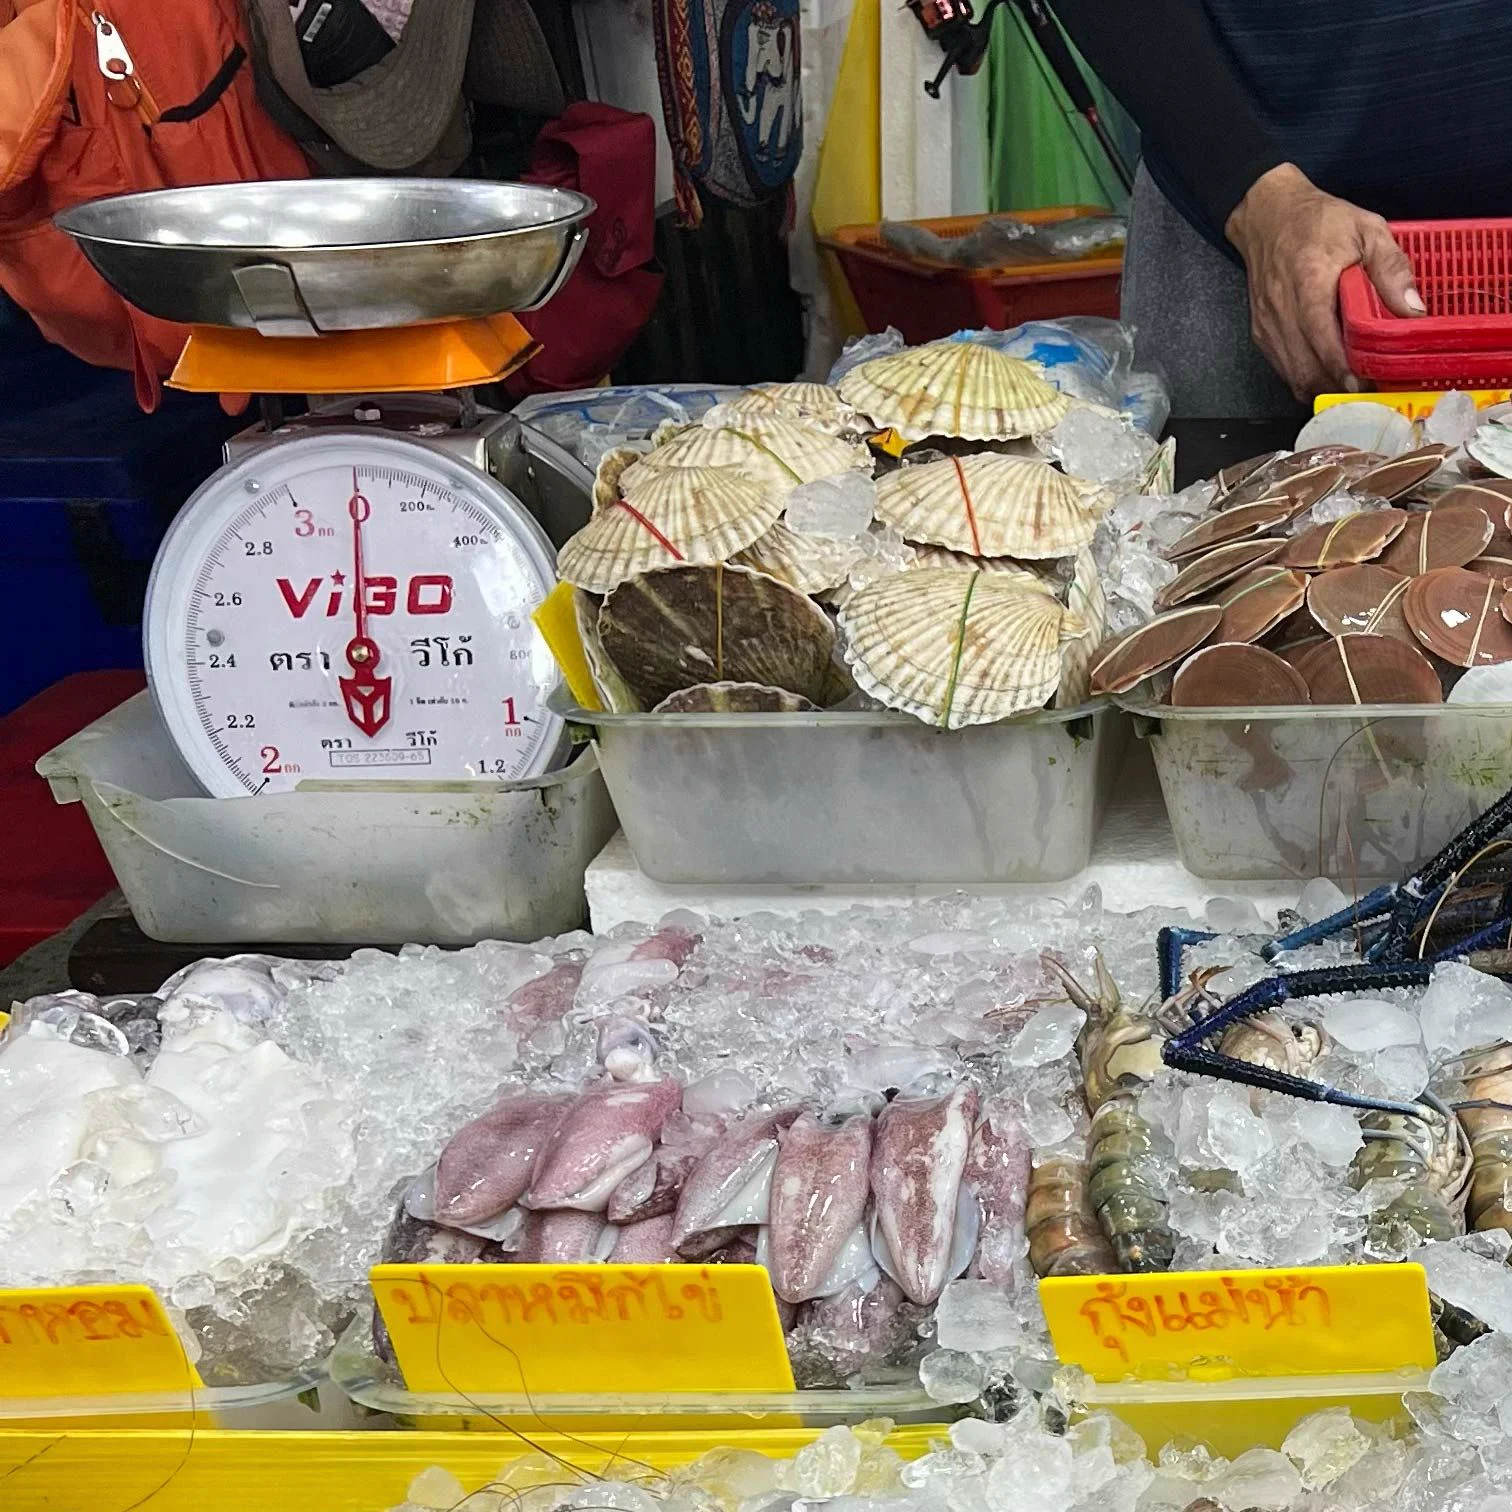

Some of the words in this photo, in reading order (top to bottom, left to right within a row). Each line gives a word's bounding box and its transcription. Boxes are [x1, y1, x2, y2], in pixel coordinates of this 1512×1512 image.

[244, 541, 274, 557] 2.8
[214, 592, 243, 607] 2.6
[209, 653, 238, 668] 2.4
[269, 650, 331, 671] ตรา
[410, 635, 474, 668] วีโก้
[501, 696, 521, 725] 1
[227, 714, 256, 729] 2.2
[321, 737, 352, 750] ตรา
[405, 730, 438, 747] วีโก้
[478, 758, 506, 774] 1.2
